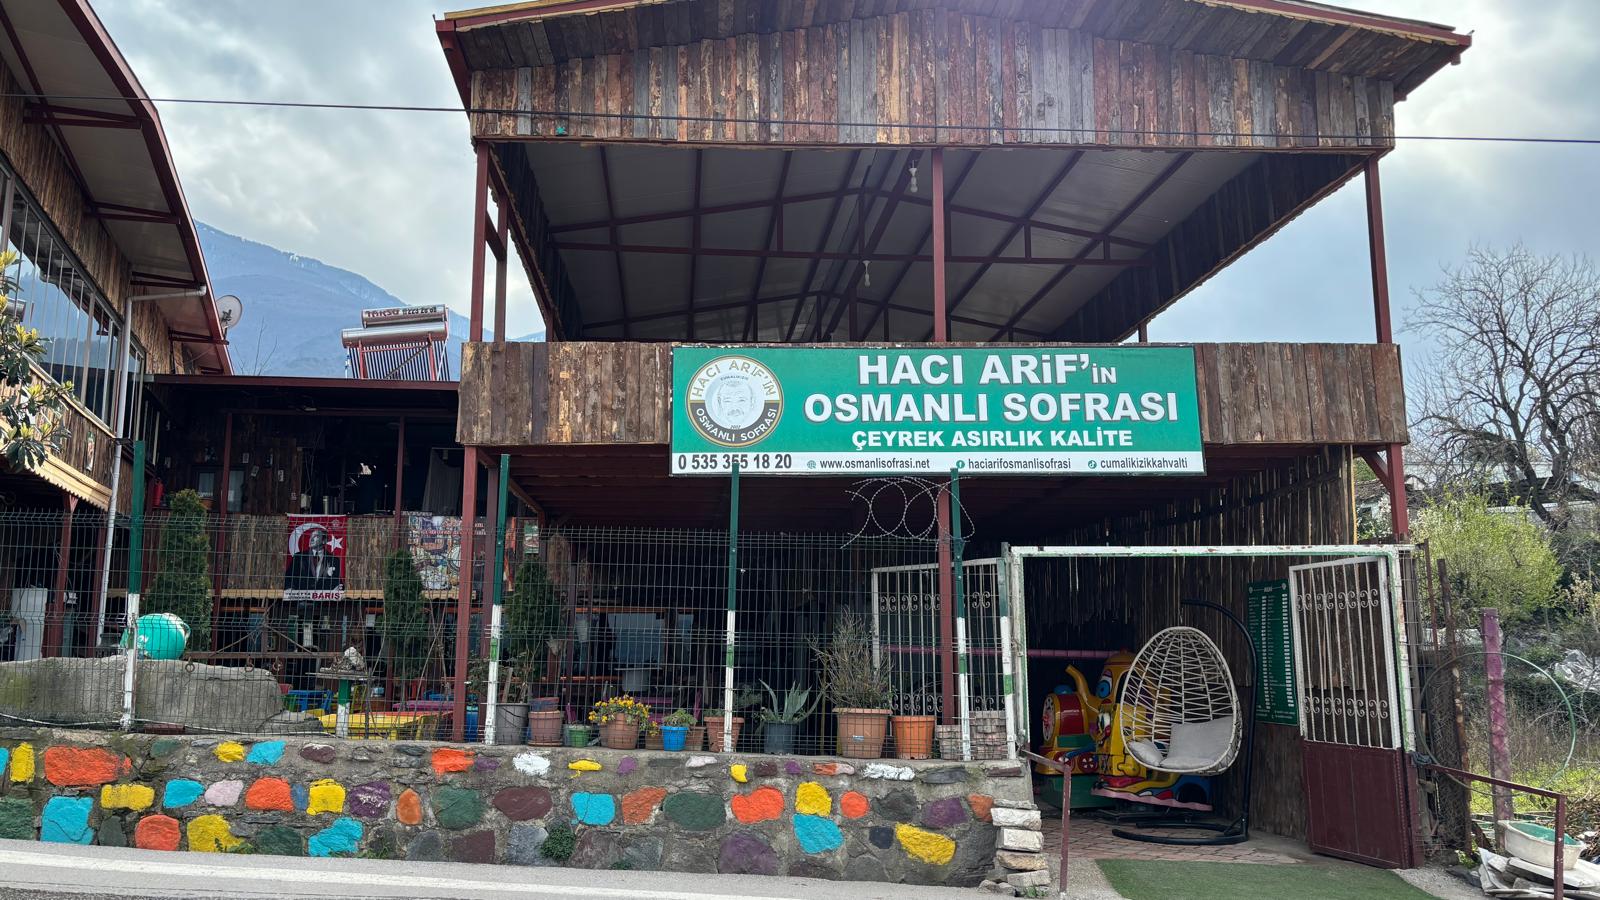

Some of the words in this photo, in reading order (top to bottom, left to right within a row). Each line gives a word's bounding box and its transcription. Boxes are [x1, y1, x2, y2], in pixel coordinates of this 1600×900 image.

[691, 364, 721, 397] HACI
[858, 354, 964, 385] HACI
[803, 393, 988, 423] OSMANLI
[1003, 392, 1179, 423] SOFRASI
[696, 408, 736, 442] OSMANLI
[740, 408, 777, 441] SOFRASI
[851, 430, 944, 451] ÇEYREK
[951, 430, 1044, 447] ASIRLIK
[1050, 426, 1133, 447] KALİTE
[678, 454, 687, 470] 0
[691, 454, 718, 469] 535
[753, 454, 771, 469] 18
[774, 454, 792, 469] 20
[819, 458, 930, 470] www.osmanlisofrasi.net
[968, 458, 1071, 470] haciarifosmanlisofrasi
[1100, 458, 1188, 469] cumalikizikkahvalti
